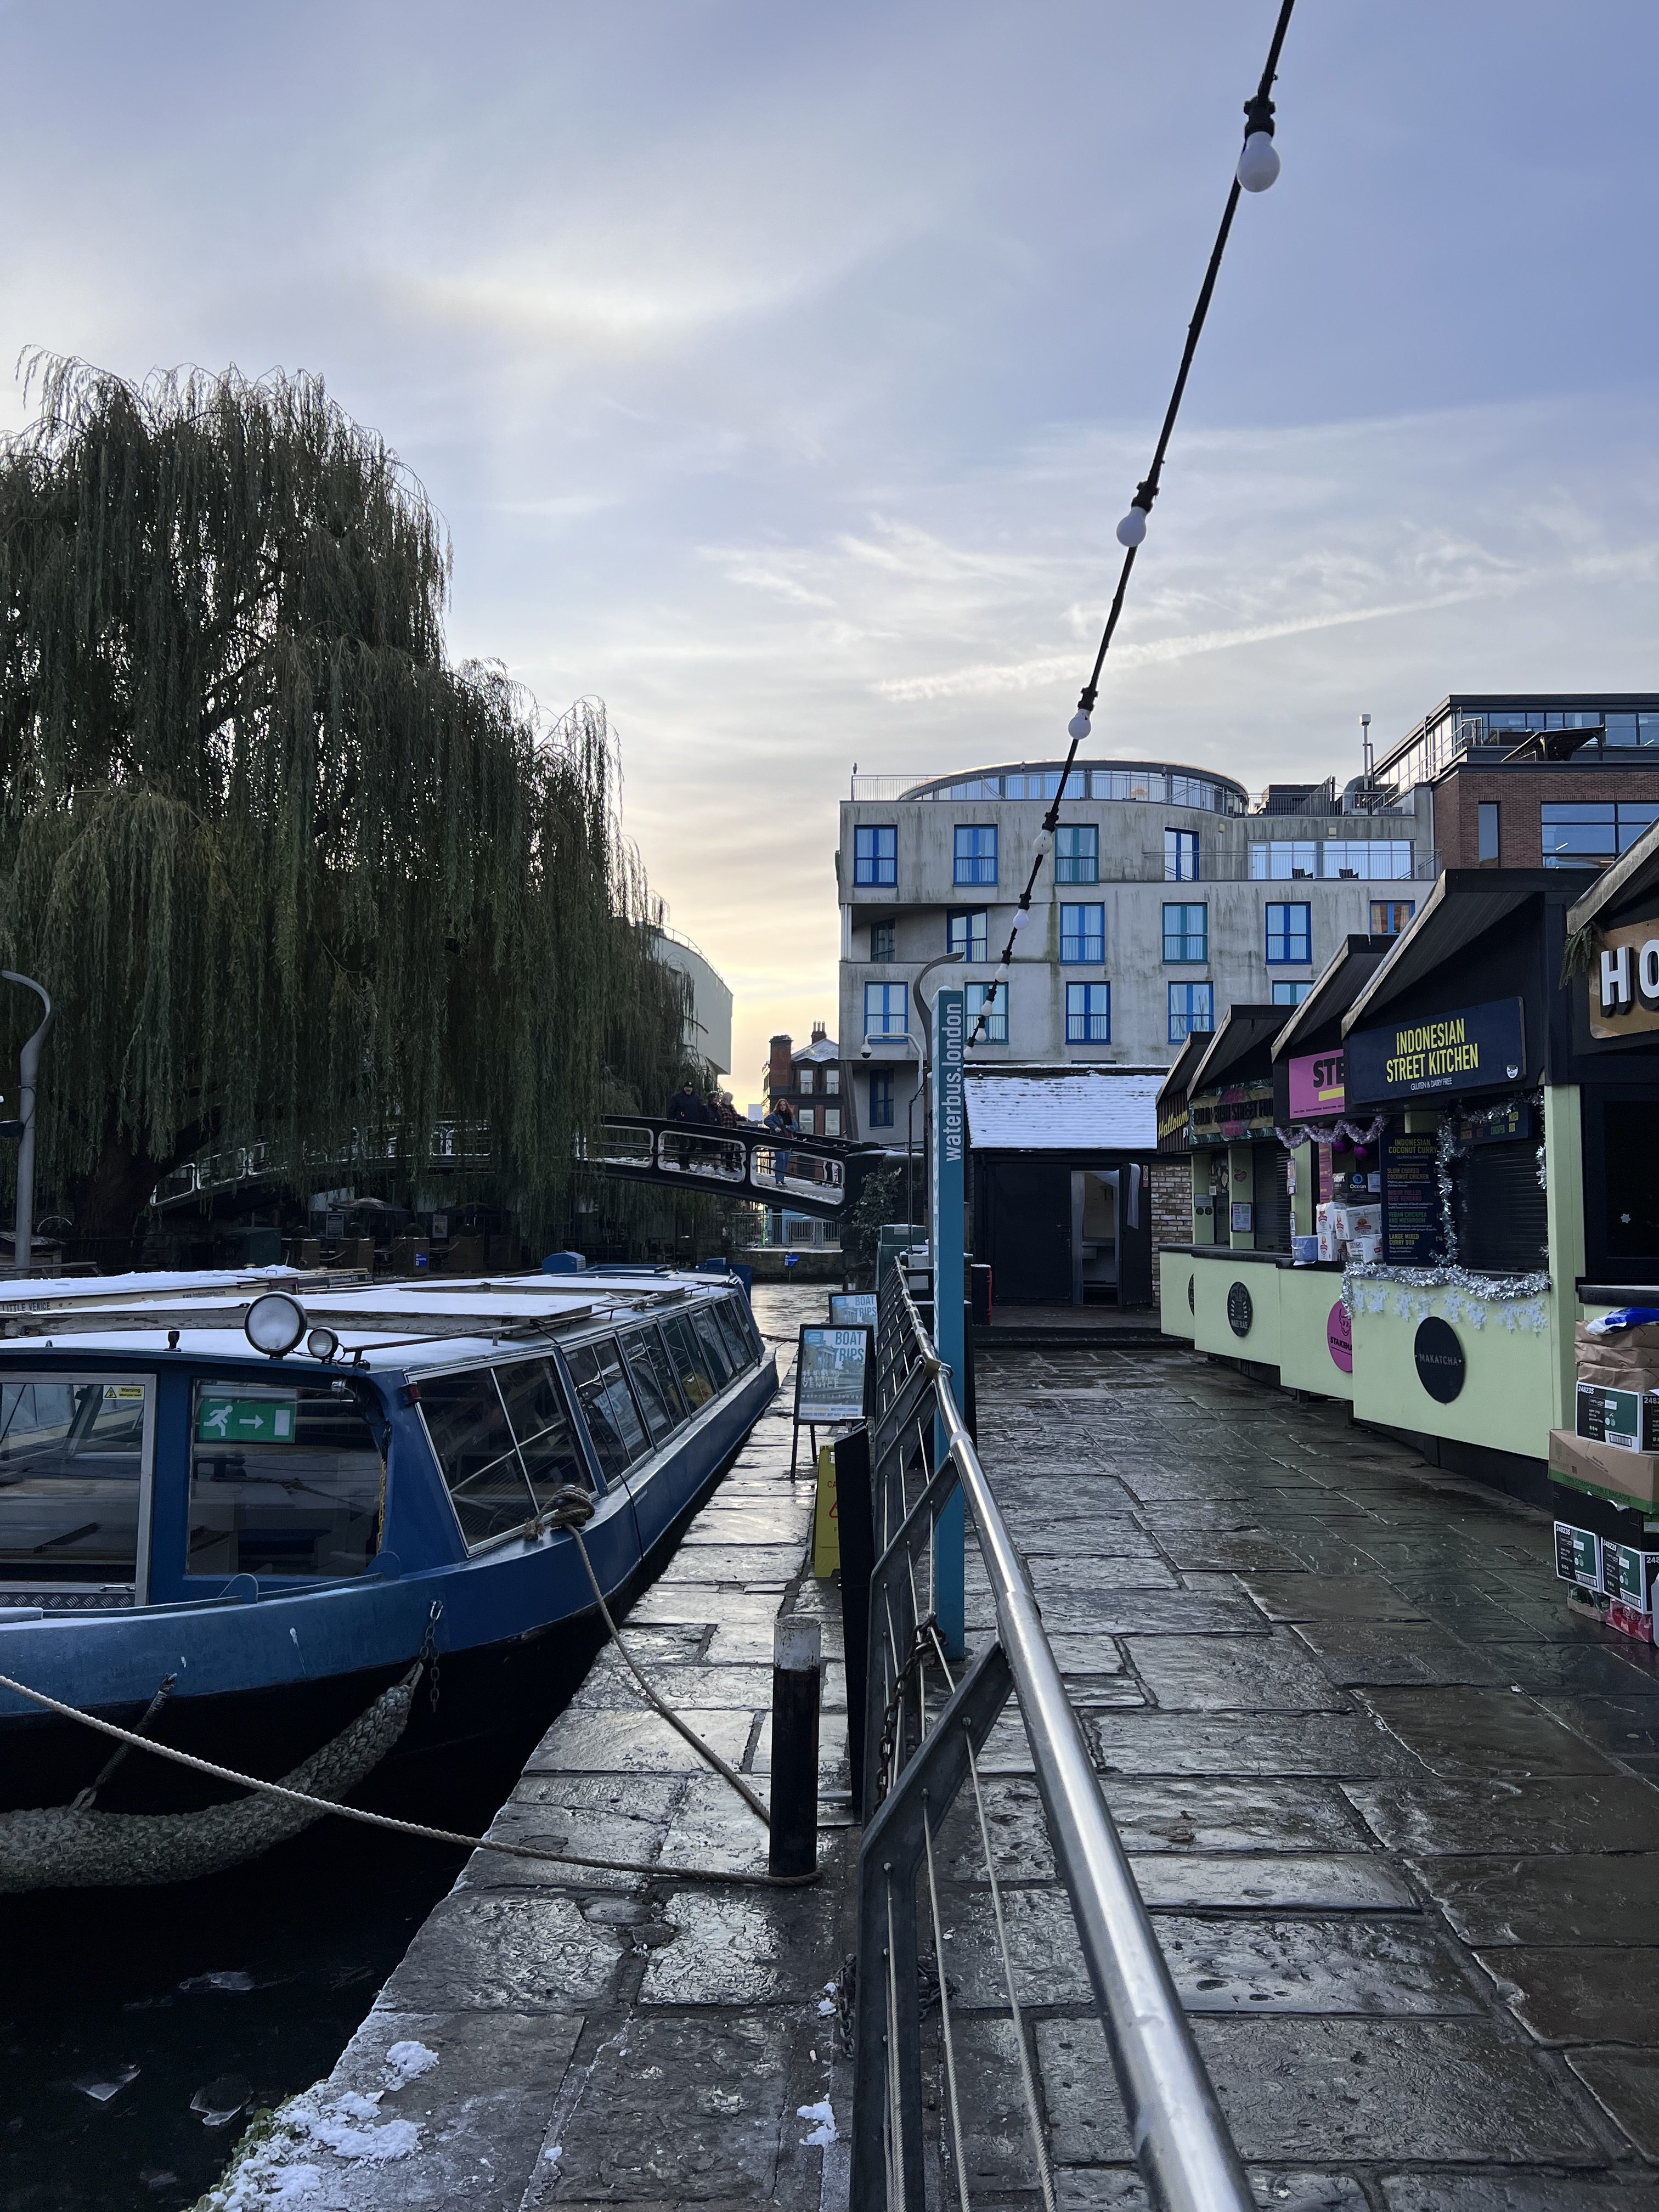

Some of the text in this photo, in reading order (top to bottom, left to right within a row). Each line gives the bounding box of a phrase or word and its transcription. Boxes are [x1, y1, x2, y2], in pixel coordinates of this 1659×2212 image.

[1396, 1018, 1465, 1056] INDONESIAN
[1386, 1043, 1479, 1083] STREET KITCHEN
[941, 1003, 961, 1161] waterbus.london
[1410, 1081, 1426, 1091] GLUTEN
[1431, 1079, 1442, 1087] DAIRY
[1443, 1077, 1452, 1086] FREE
[29, 1302, 50, 1311] VENICE
[855, 1296, 875, 1306] BOAT
[835, 1331, 864, 1345] BOAT
[833, 1348, 864, 1363] TRIPS
[1419, 1353, 1458, 1366] MAKATCHA
[1578, 1385, 1595, 1395] 248235
[1556, 1525, 1571, 1536] 248235
[1602, 1539, 1617, 1551] 248235
